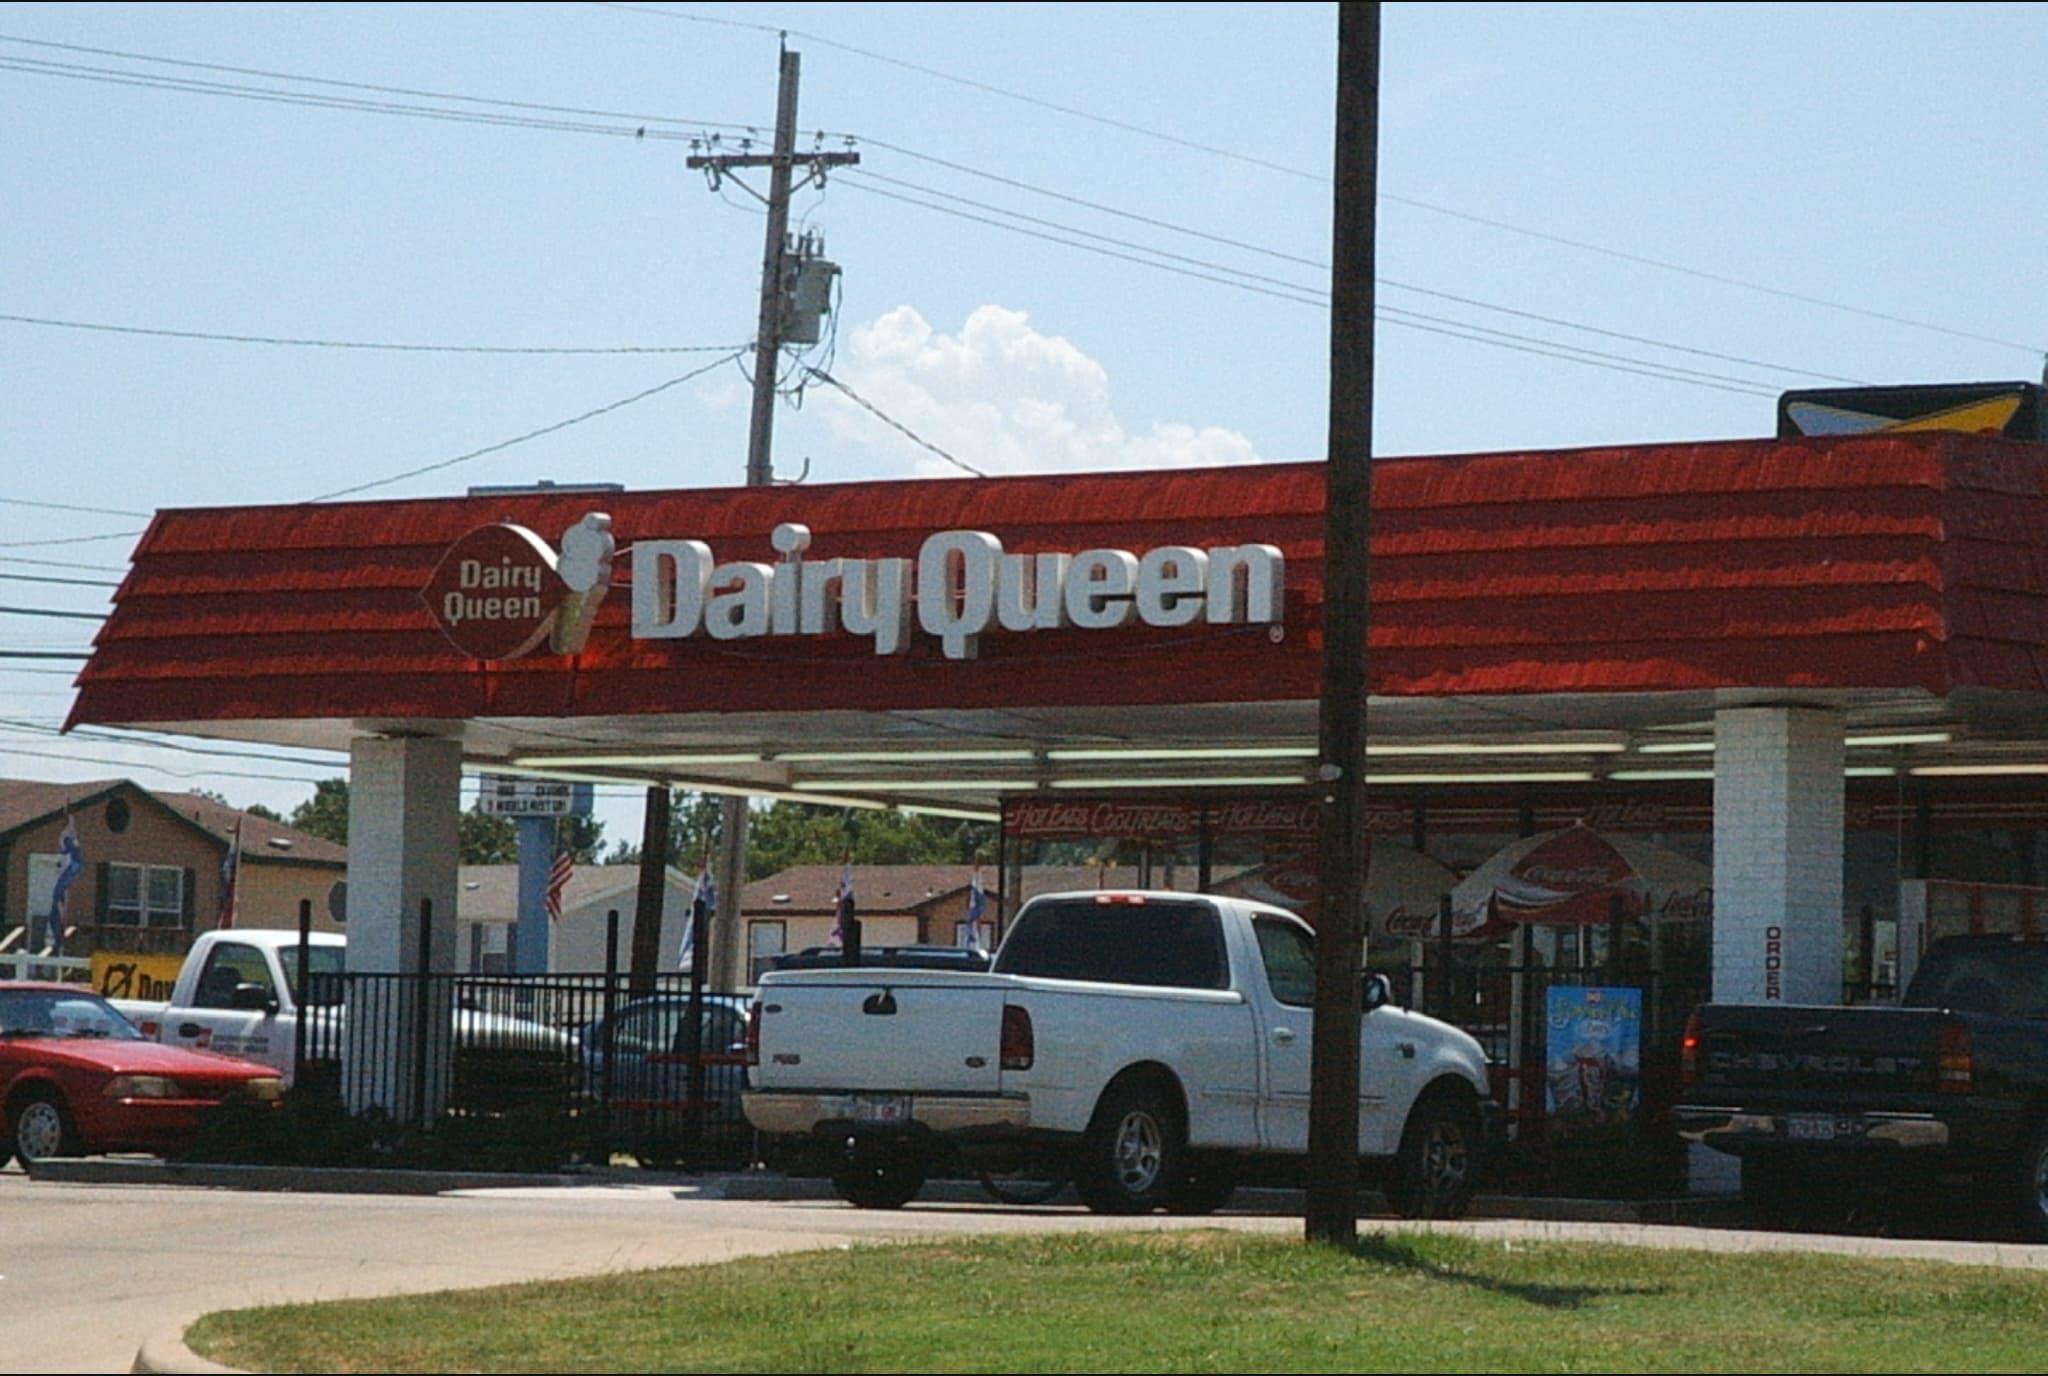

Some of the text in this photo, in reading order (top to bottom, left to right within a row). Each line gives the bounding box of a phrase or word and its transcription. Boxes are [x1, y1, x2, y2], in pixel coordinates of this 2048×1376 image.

[460, 556, 541, 592] Dairy
[631, 524, 1284, 660] Dairy Queen
[444, 592, 540, 627] Queen
[1765, 926, 1782, 1001] ORDER
